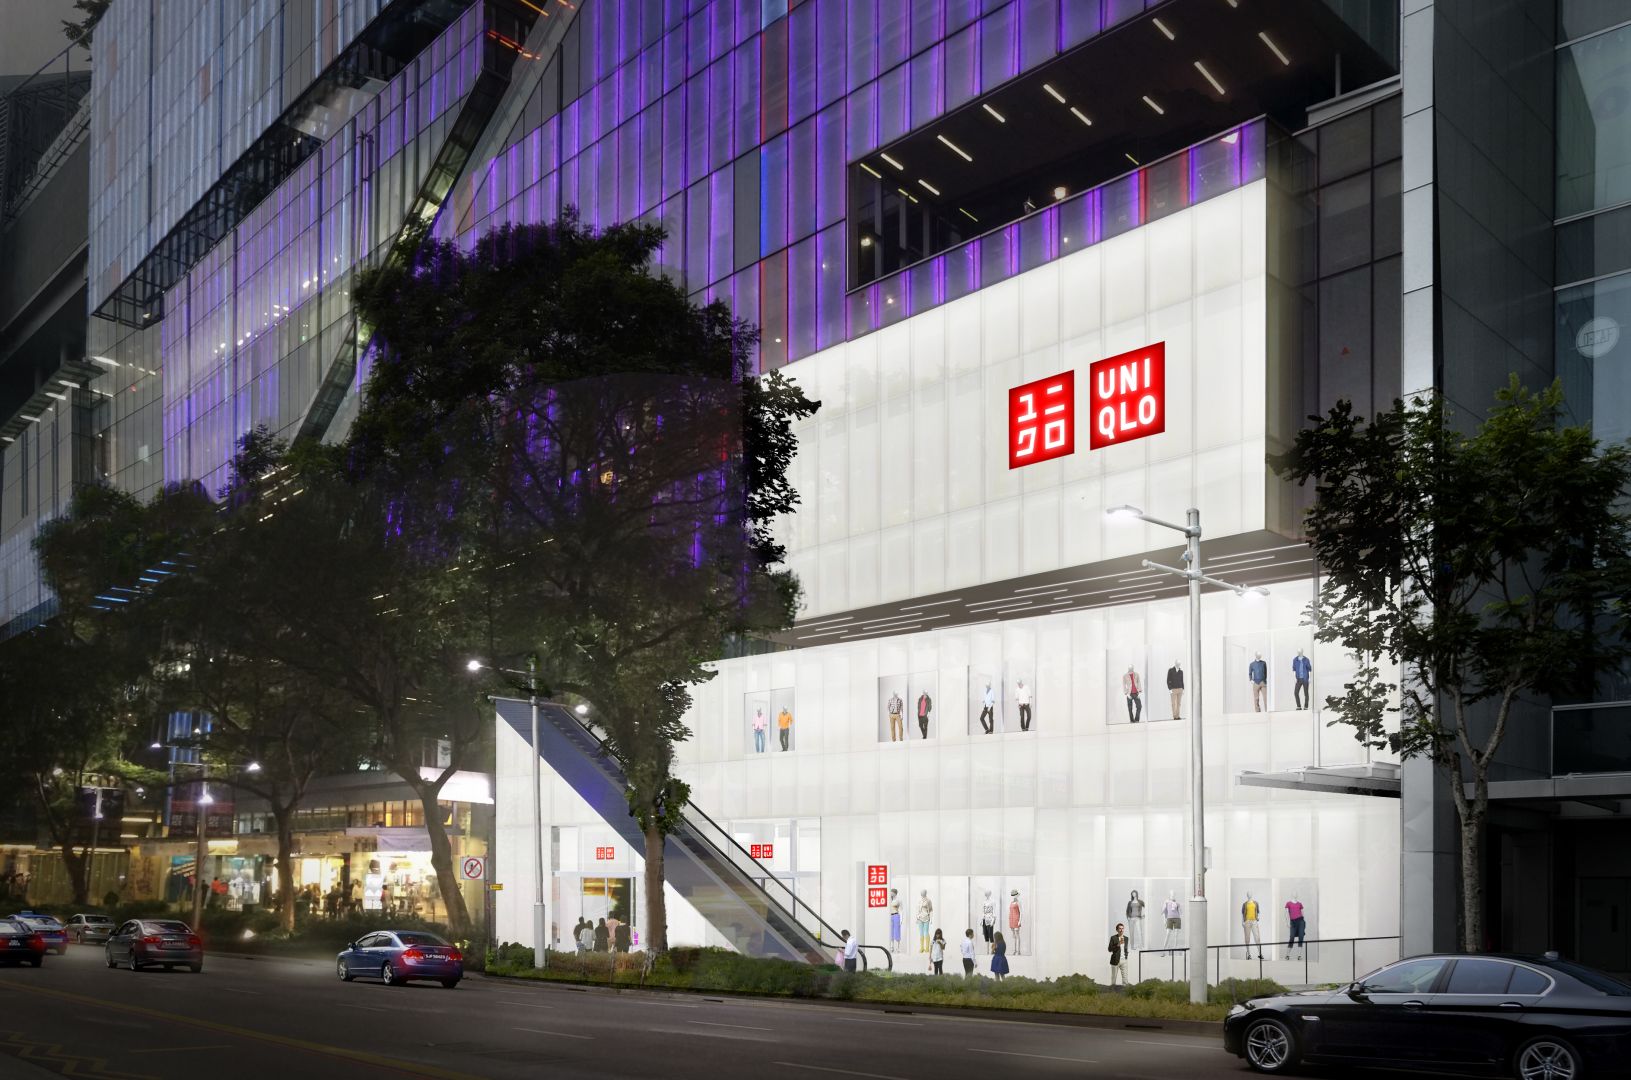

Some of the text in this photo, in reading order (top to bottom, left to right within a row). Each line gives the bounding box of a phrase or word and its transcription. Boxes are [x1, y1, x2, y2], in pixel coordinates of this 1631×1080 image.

[1098, 357, 1150, 399] UNI
[1017, 384, 1065, 423] ユニ
[1098, 395, 1156, 440] QLO
[1016, 418, 1065, 458] クロ
[870, 898, 885, 906] QLO
